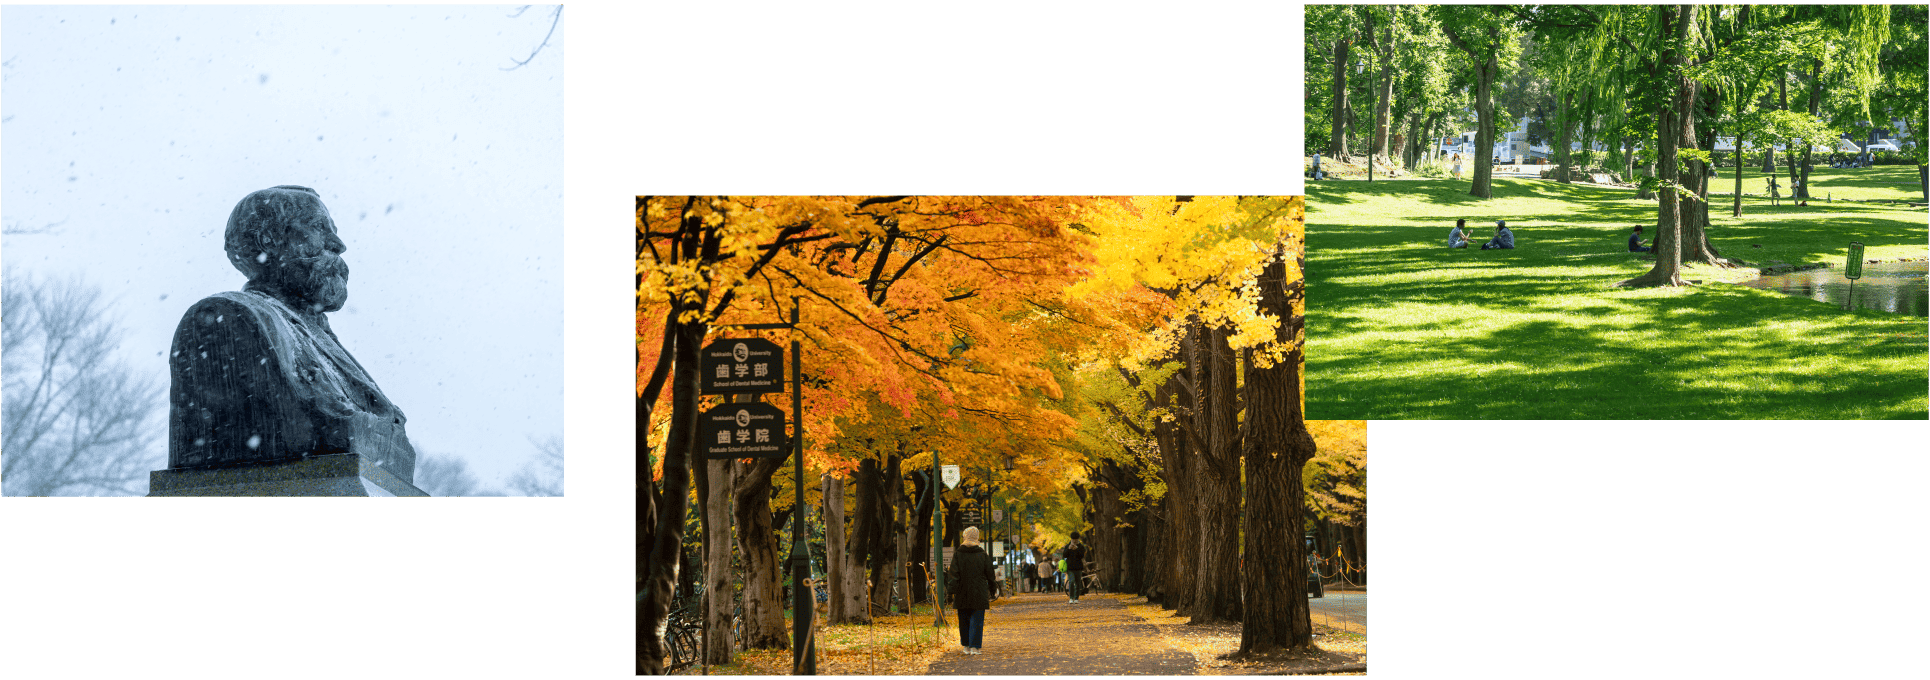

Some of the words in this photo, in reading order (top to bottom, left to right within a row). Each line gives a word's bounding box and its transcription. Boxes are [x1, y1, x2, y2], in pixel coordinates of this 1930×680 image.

[716, 362, 768, 378] 歯学部
[717, 428, 770, 444] 歯学院
